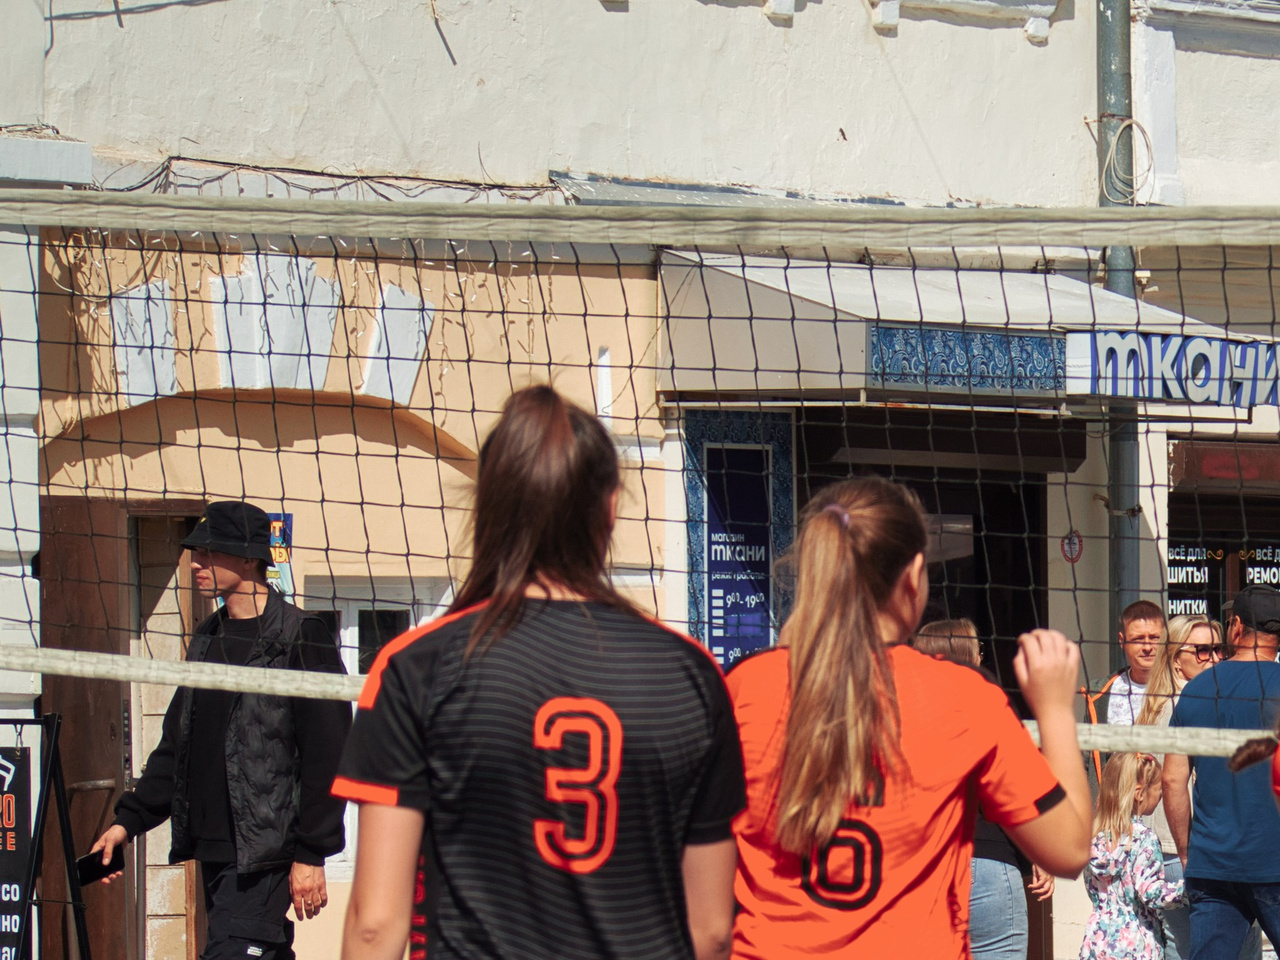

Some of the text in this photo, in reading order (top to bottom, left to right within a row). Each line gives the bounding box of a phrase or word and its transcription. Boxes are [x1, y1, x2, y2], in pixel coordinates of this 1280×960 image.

[1187, 548, 1207, 562] ДЛЯ
[1256, 546, 1273, 560] ВСЁ
[1167, 566, 1209, 583] ШИТЬЯ
[1168, 599, 1207, 615] НИТКИ
[533, 697, 624, 874] 3
